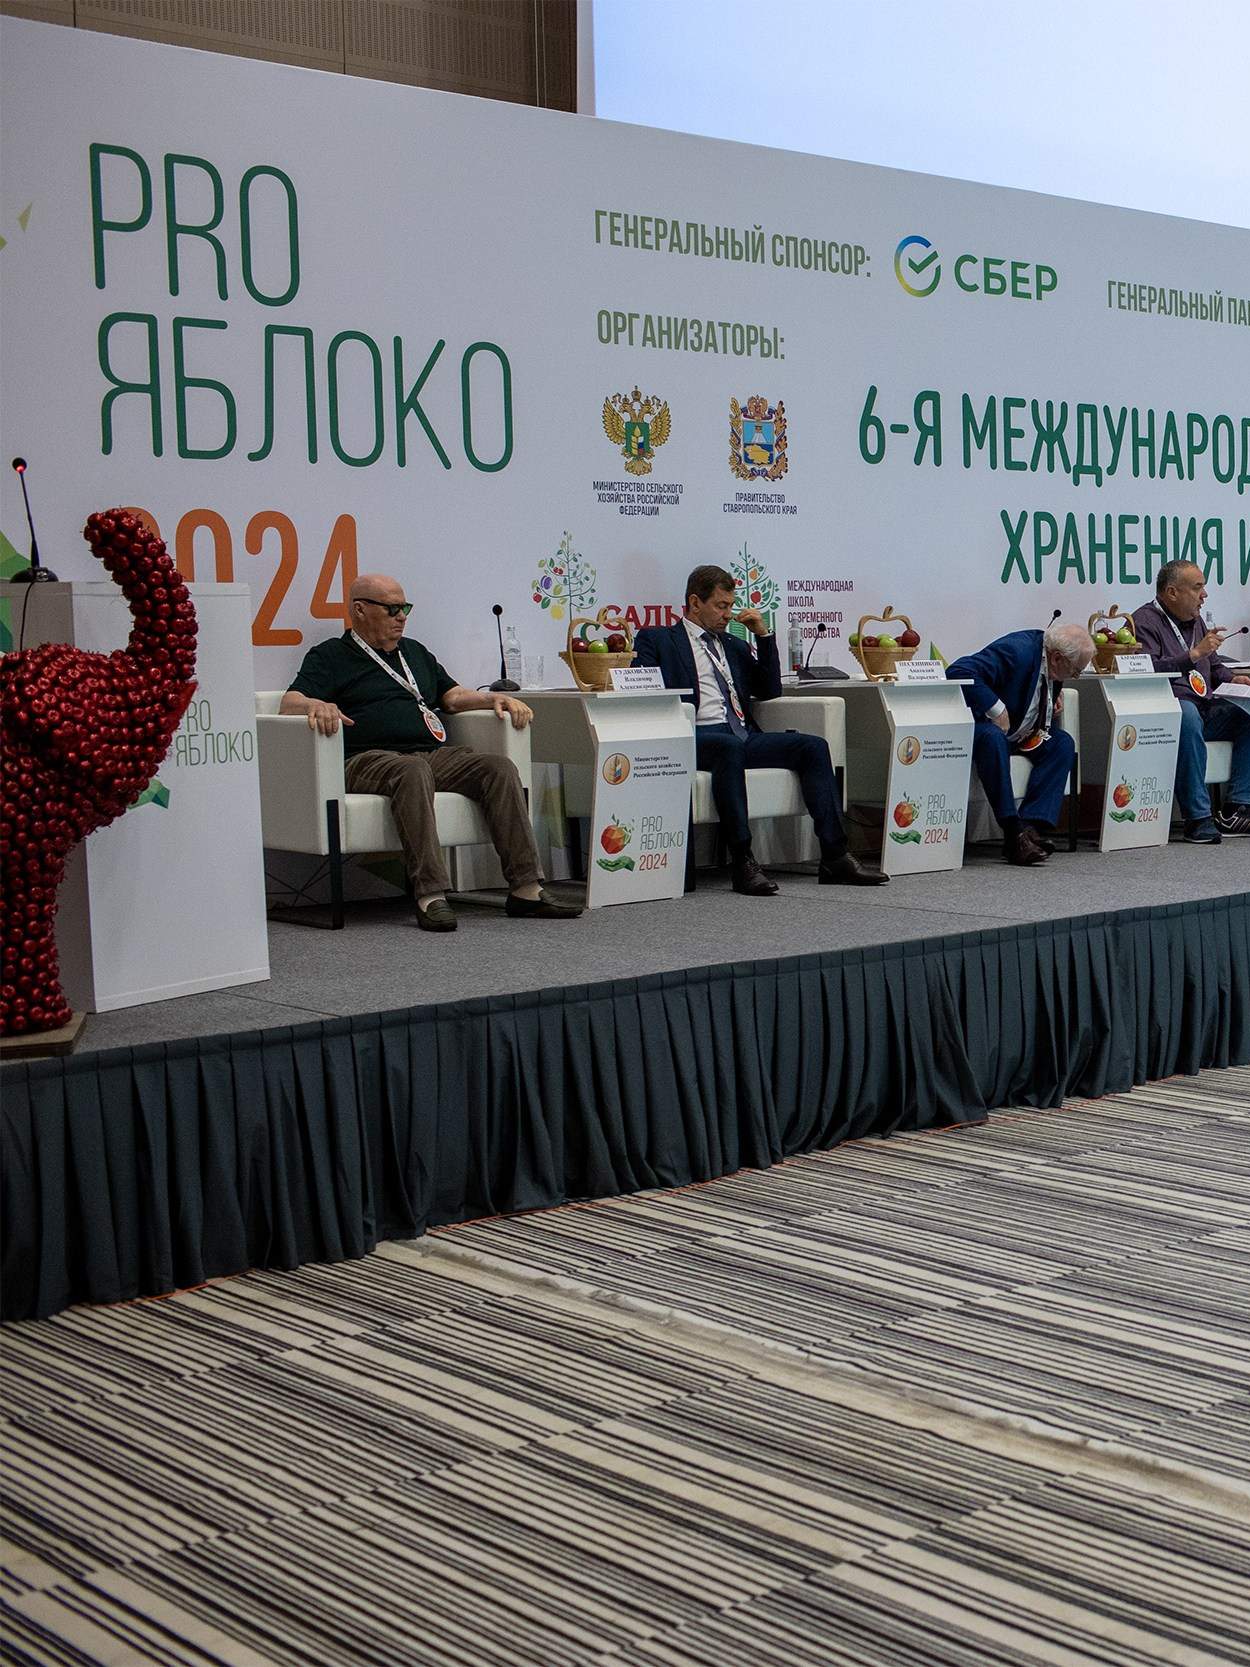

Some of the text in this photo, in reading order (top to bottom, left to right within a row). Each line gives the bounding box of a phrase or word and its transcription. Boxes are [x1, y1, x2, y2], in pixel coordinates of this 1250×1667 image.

[89, 142, 300, 307] PRO
[594, 209, 872, 278] ГЕНЕРАЛЬНЫЙ СПОНСОР:
[954, 253, 1058, 300] СБЕР
[1107, 279, 1224, 324] ГЕНЕРАЛЬНЫЙ
[596, 308, 786, 360] ОРГАНИЗАТОРЫ:
[98, 312, 514, 473] ЯБЛОКО
[858, 385, 942, 468] 6-Я
[592, 481, 684, 494] МИНИСТЕРСТВО СЕЛЬСКОГО
[597, 492, 680, 505] ХОЗЯЙСТВА РОССИЙСКОЙ
[735, 492, 786, 504] ПРАВИТЕЛЬСТВО
[619, 505, 660, 516] ФЕДЕРАЦИИ
[723, 503, 798, 515] СТАВРОПОЛЬСКОГО КРАЯ
[1000, 509, 1224, 586] ХРАНЕНИЯ
[120, 506, 359, 646] 024
[787, 580, 854, 592] МЕЖДУНАРОДНАЯ
[787, 596, 814, 607] ШКОЛА
[180, 700, 211, 732] RO
[175, 730, 253, 767] ЯБЛОКО
[1141, 776, 1157, 791] PRO
[927, 794, 946, 809] PRO
[1140, 789, 1171, 805] ЯБЛОКО
[926, 808, 963, 825] ЯБЛОКО
[1138, 807, 1159, 822] 2024
[641, 815, 663, 833] PRO
[640, 831, 684, 850] ЯБЛОКО
[924, 828, 949, 844] 2024
[639, 853, 667, 871] 2024
